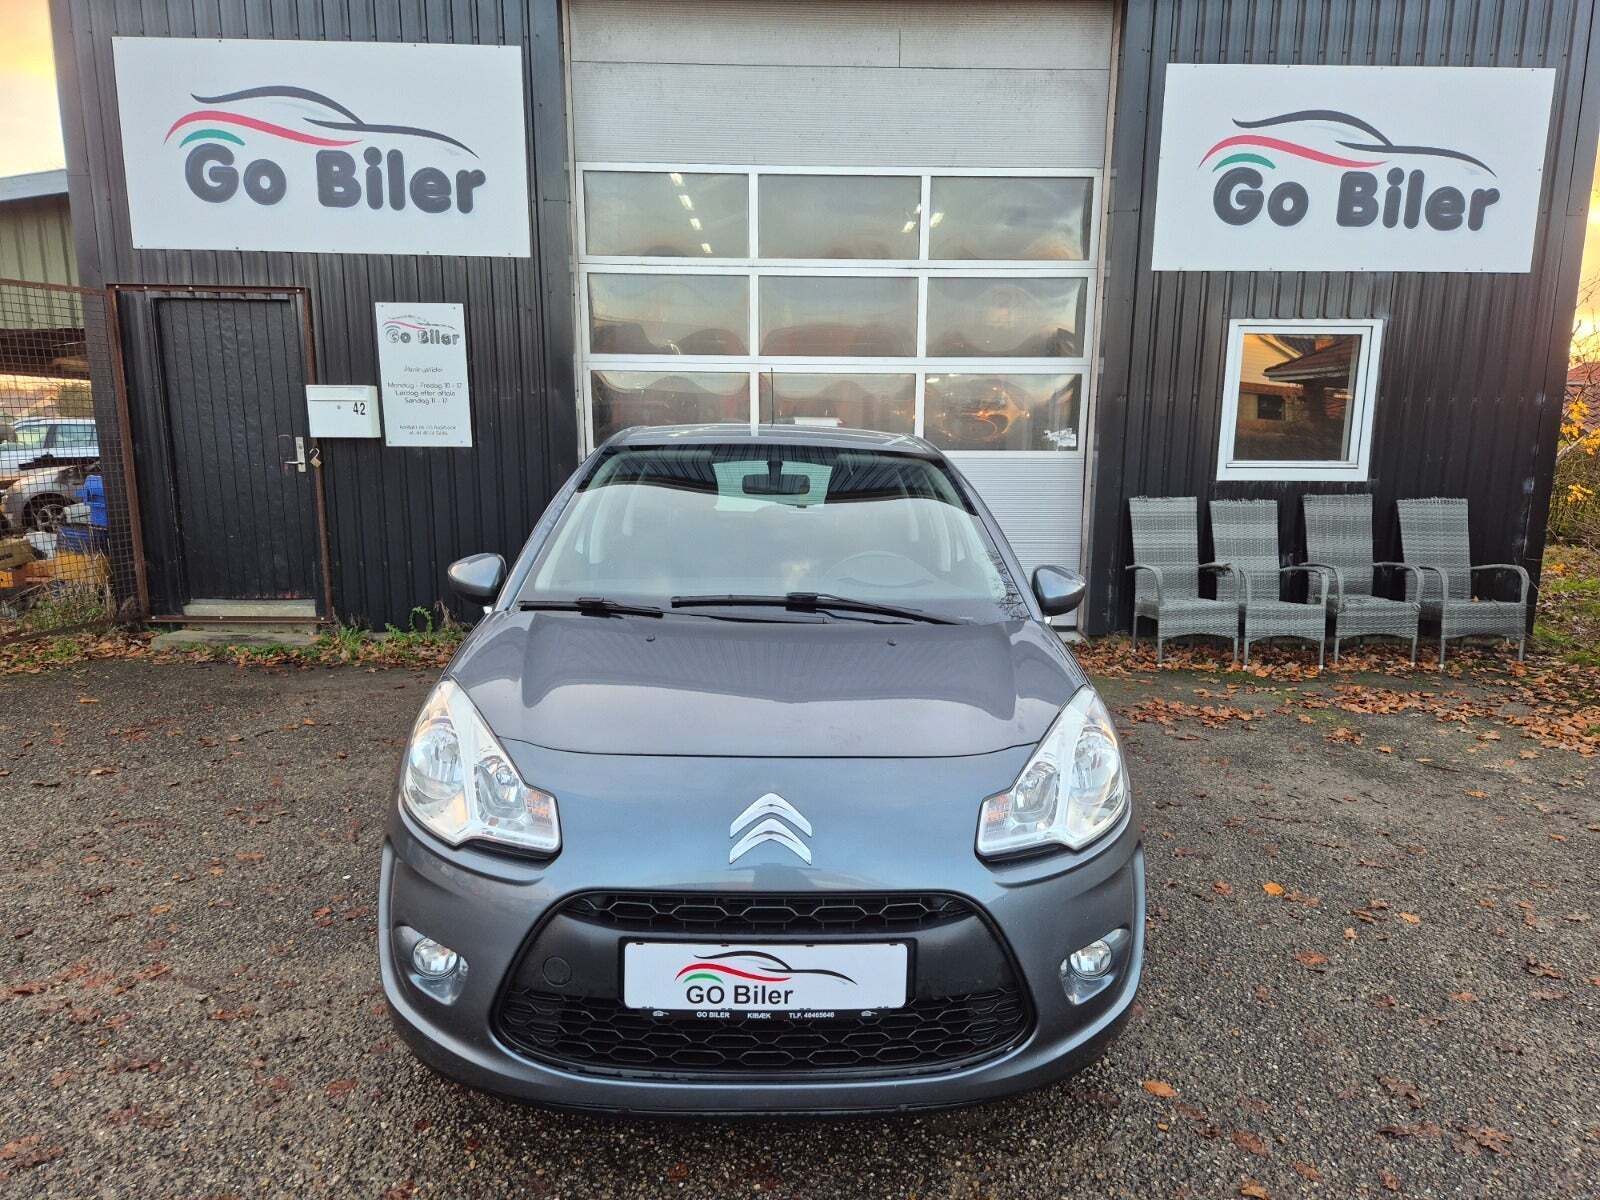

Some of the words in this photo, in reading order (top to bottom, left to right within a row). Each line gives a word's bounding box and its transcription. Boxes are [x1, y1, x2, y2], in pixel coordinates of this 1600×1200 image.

[185, 143, 287, 206] Go
[316, 147, 486, 214] Biler
[1213, 167, 1309, 227] Go
[1336, 167, 1500, 232] Biler
[388, 329, 411, 343] Go
[418, 329, 460, 345] Biler
[353, 402, 366, 416] 42
[686, 985, 725, 1004] GO
[734, 985, 794, 1005] Biler
